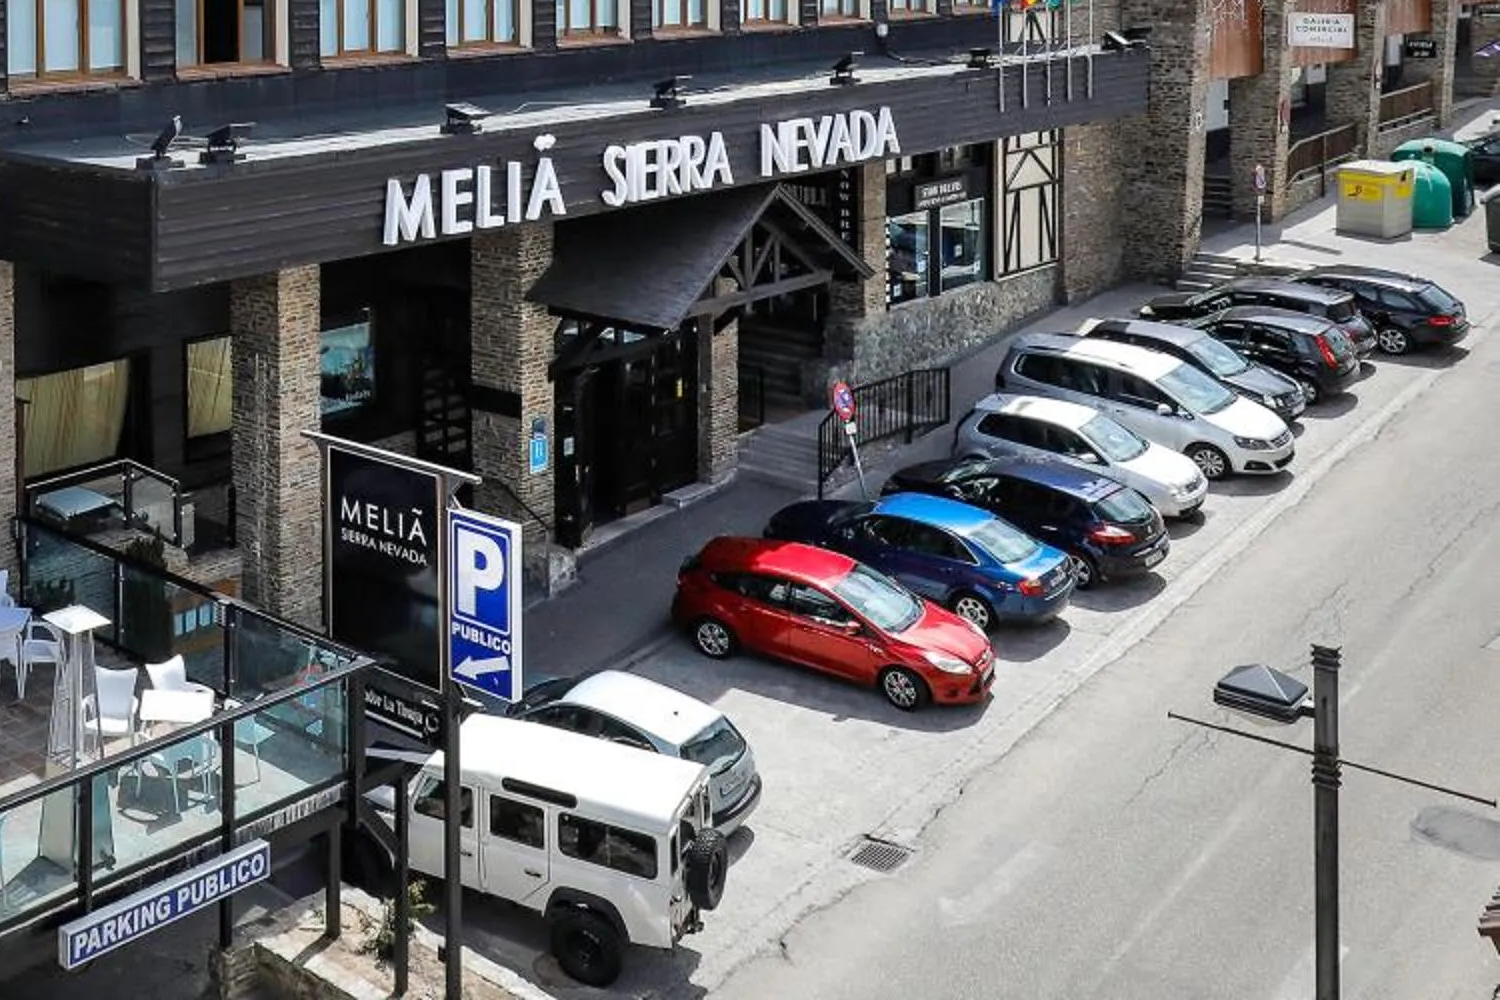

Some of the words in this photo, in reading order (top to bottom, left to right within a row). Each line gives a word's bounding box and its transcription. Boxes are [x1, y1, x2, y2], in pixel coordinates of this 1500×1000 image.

[601, 131, 735, 207] SIERRA
[760, 106, 901, 177] NEVADA
[341, 527, 377, 550] SIERRA
[380, 540, 428, 567] NEVADA
[457, 528, 505, 617] P
[452, 621, 511, 655] PUBLICO
[73, 896, 171, 959] PARKING
[177, 853, 265, 912] PUBLICO
